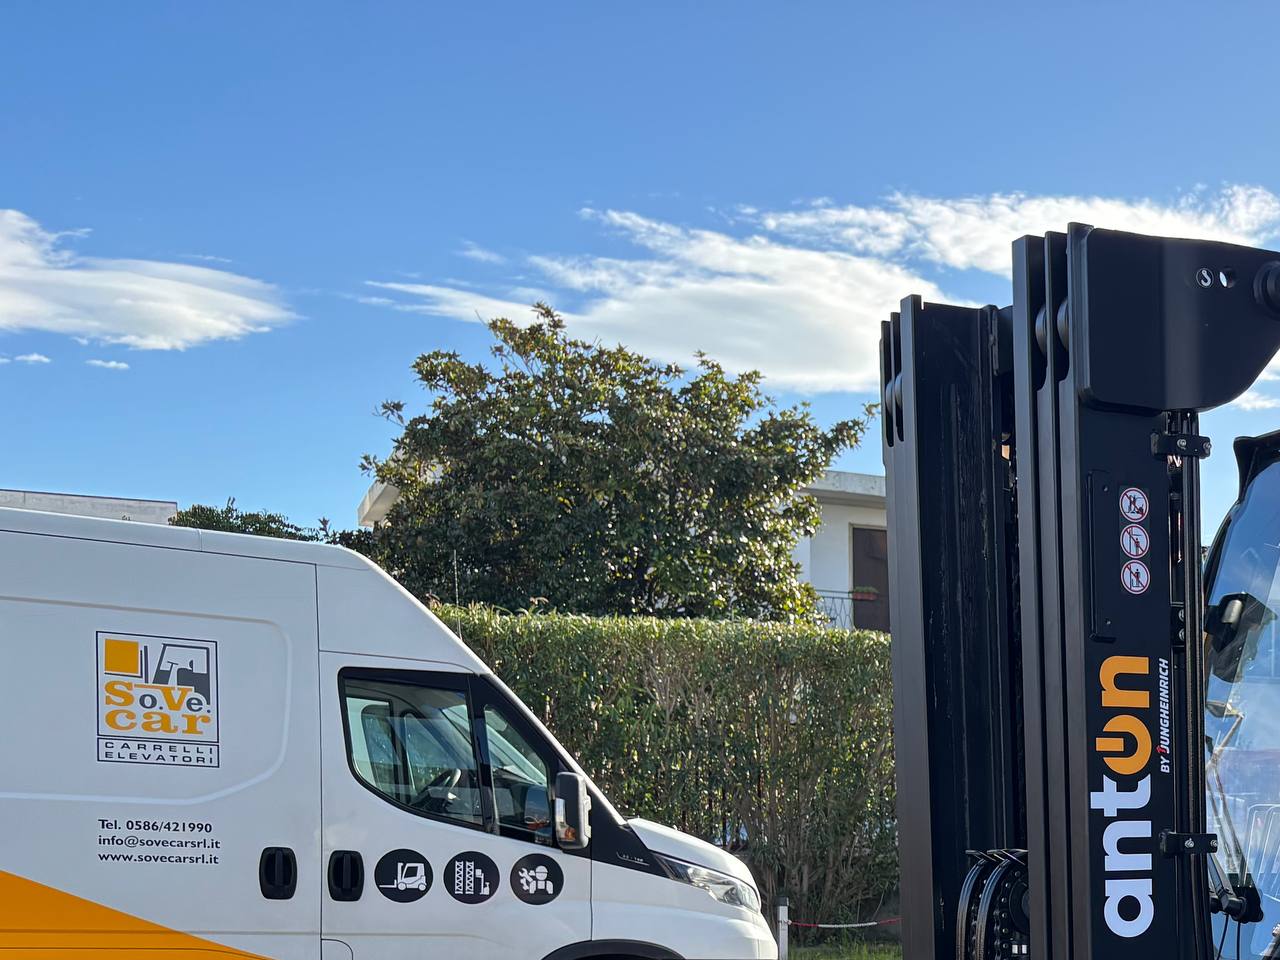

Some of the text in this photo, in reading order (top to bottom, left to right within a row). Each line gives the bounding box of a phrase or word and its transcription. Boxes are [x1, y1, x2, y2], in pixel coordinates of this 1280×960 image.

[105, 709, 211, 735] car
[1157, 658, 1170, 773] BY JUNGHEINRICH
[105, 741, 213, 755] CARRELLI
[105, 751, 213, 764] ELEVATORI
[1090, 655, 1154, 938] anton
[98, 819, 213, 833] Tel. 0586/421990
[98, 835, 221, 849] info@sovecarsrl.it
[98, 853, 219, 865] www.sovecarsrl.it
